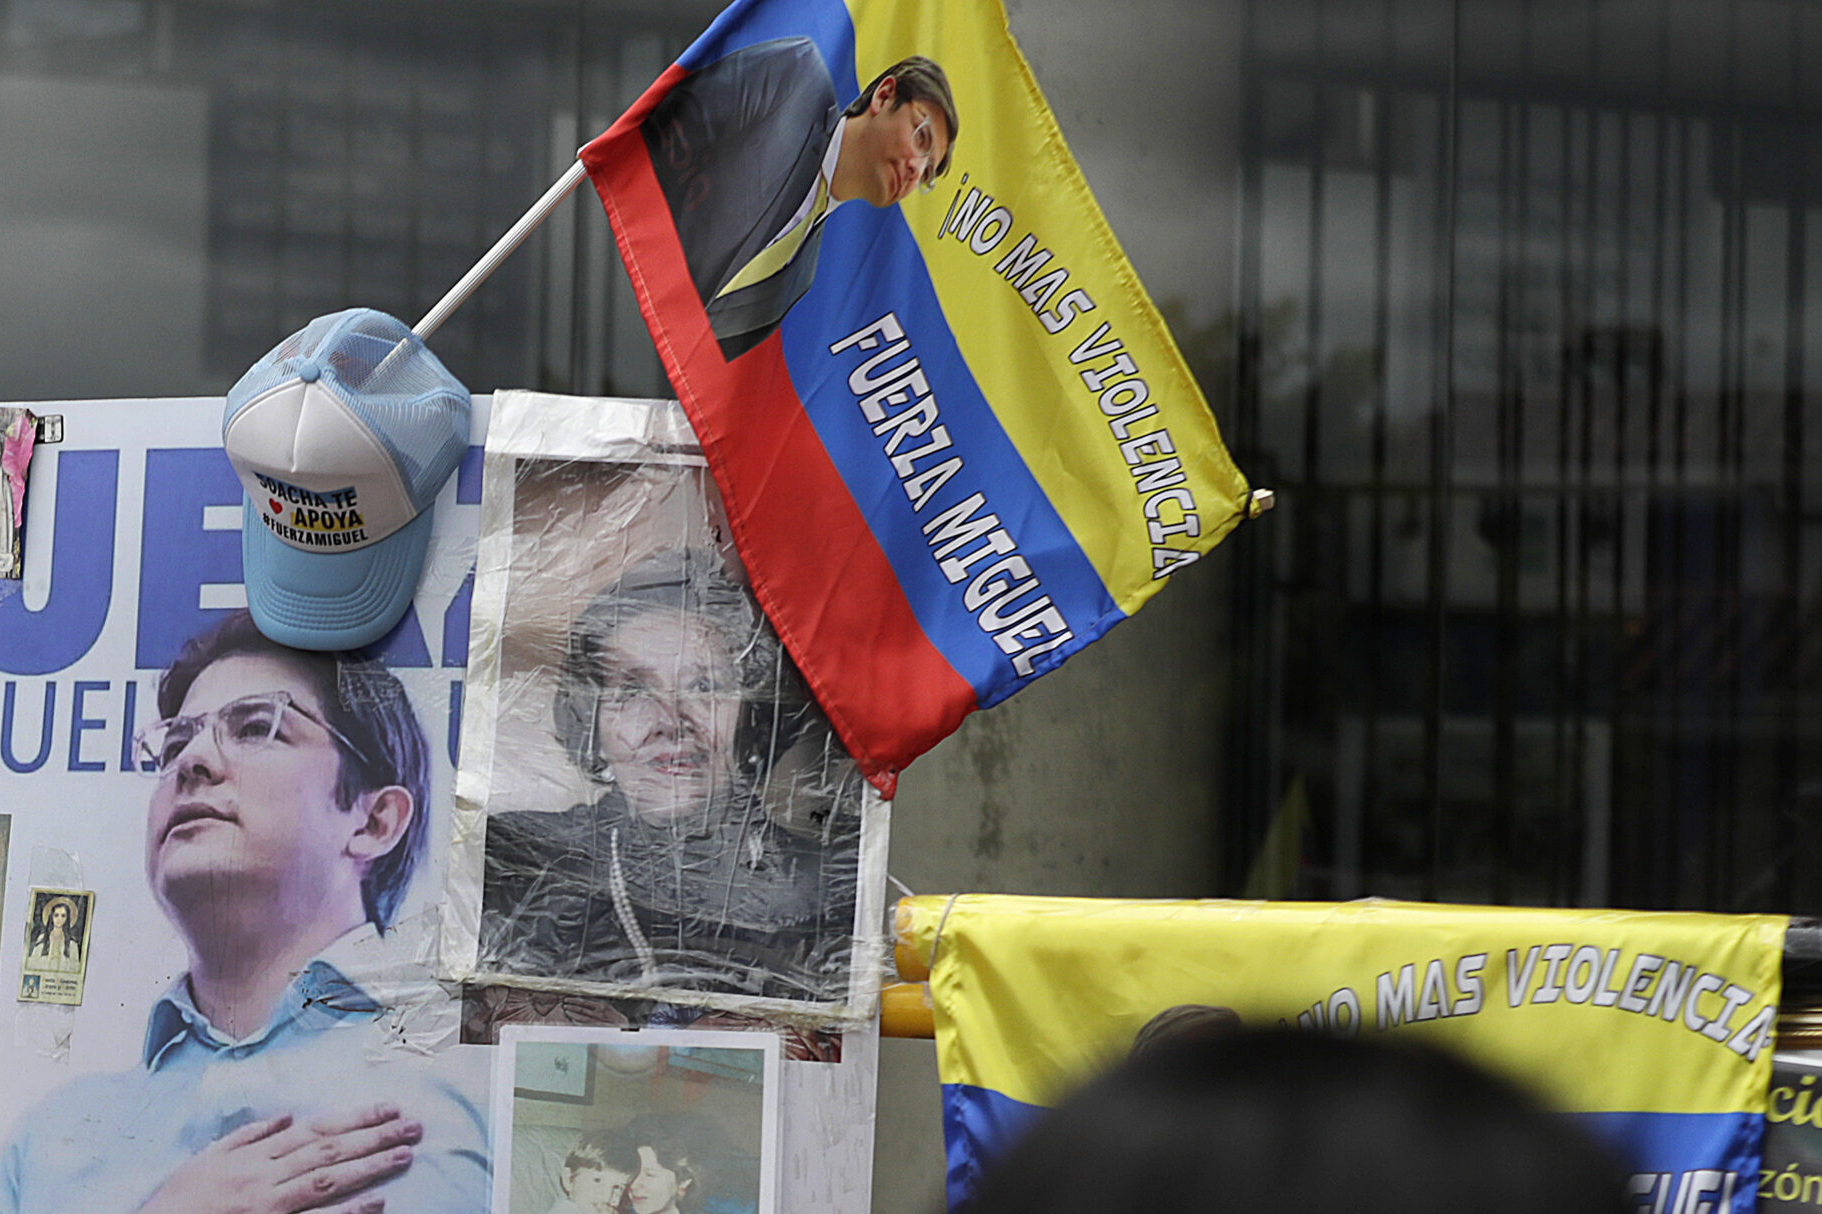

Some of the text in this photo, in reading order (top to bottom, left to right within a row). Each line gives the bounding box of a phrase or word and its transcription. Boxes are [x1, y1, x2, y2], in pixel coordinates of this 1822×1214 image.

[937, 172, 1200, 580] ¡NO MAS VIOLENCIA
[258, 475, 358, 510] SOACHA TE
[262, 512, 368, 547] #FUERZAMIGUEL
[293, 507, 363, 529] APOYA
[830, 312, 1075, 677] FUERZA MIGUEL
[1377, 952, 1488, 1031] MAS
[1506, 942, 1774, 1062] VIOLENCIA
